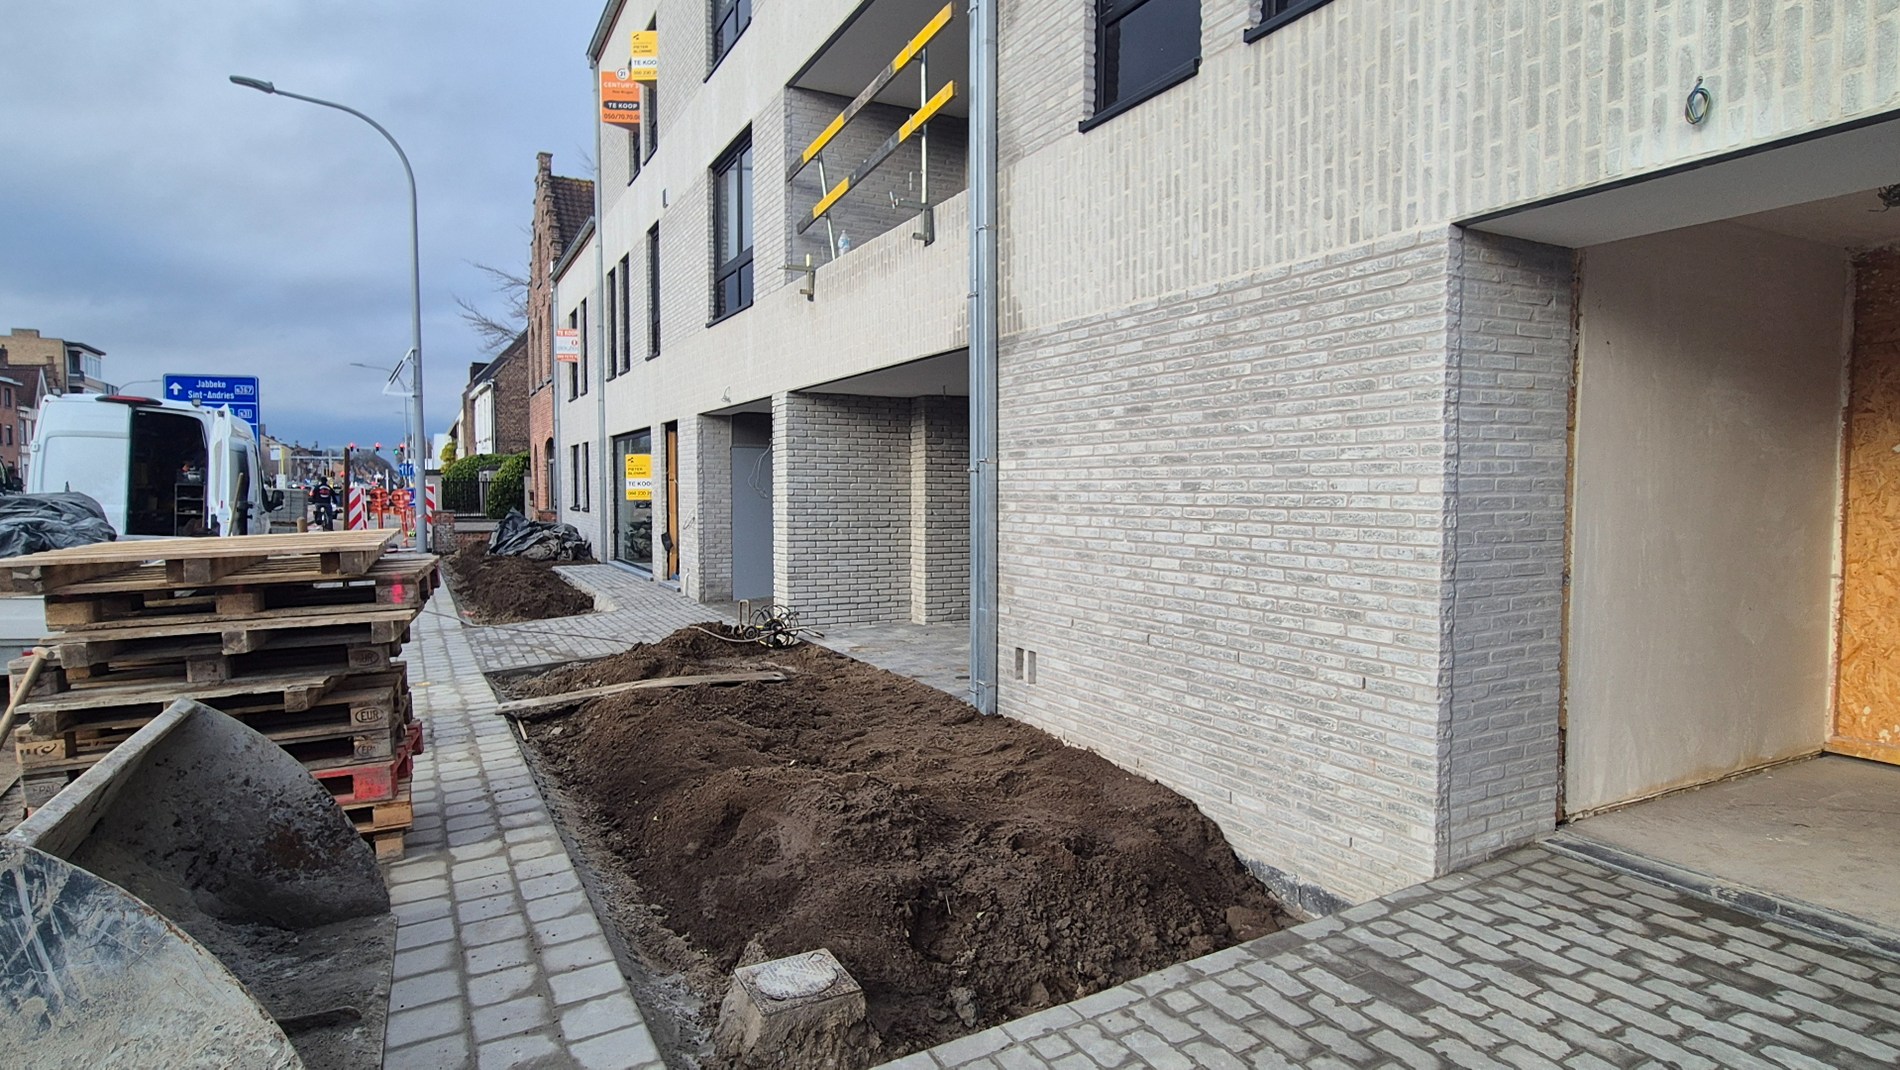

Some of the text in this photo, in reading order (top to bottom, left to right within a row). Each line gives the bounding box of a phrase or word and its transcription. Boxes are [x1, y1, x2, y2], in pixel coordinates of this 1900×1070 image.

[196, 380, 227, 389] Jabbeke
[187, 390, 235, 399] Sint-Andries
[360, 710, 379, 721] EUR
